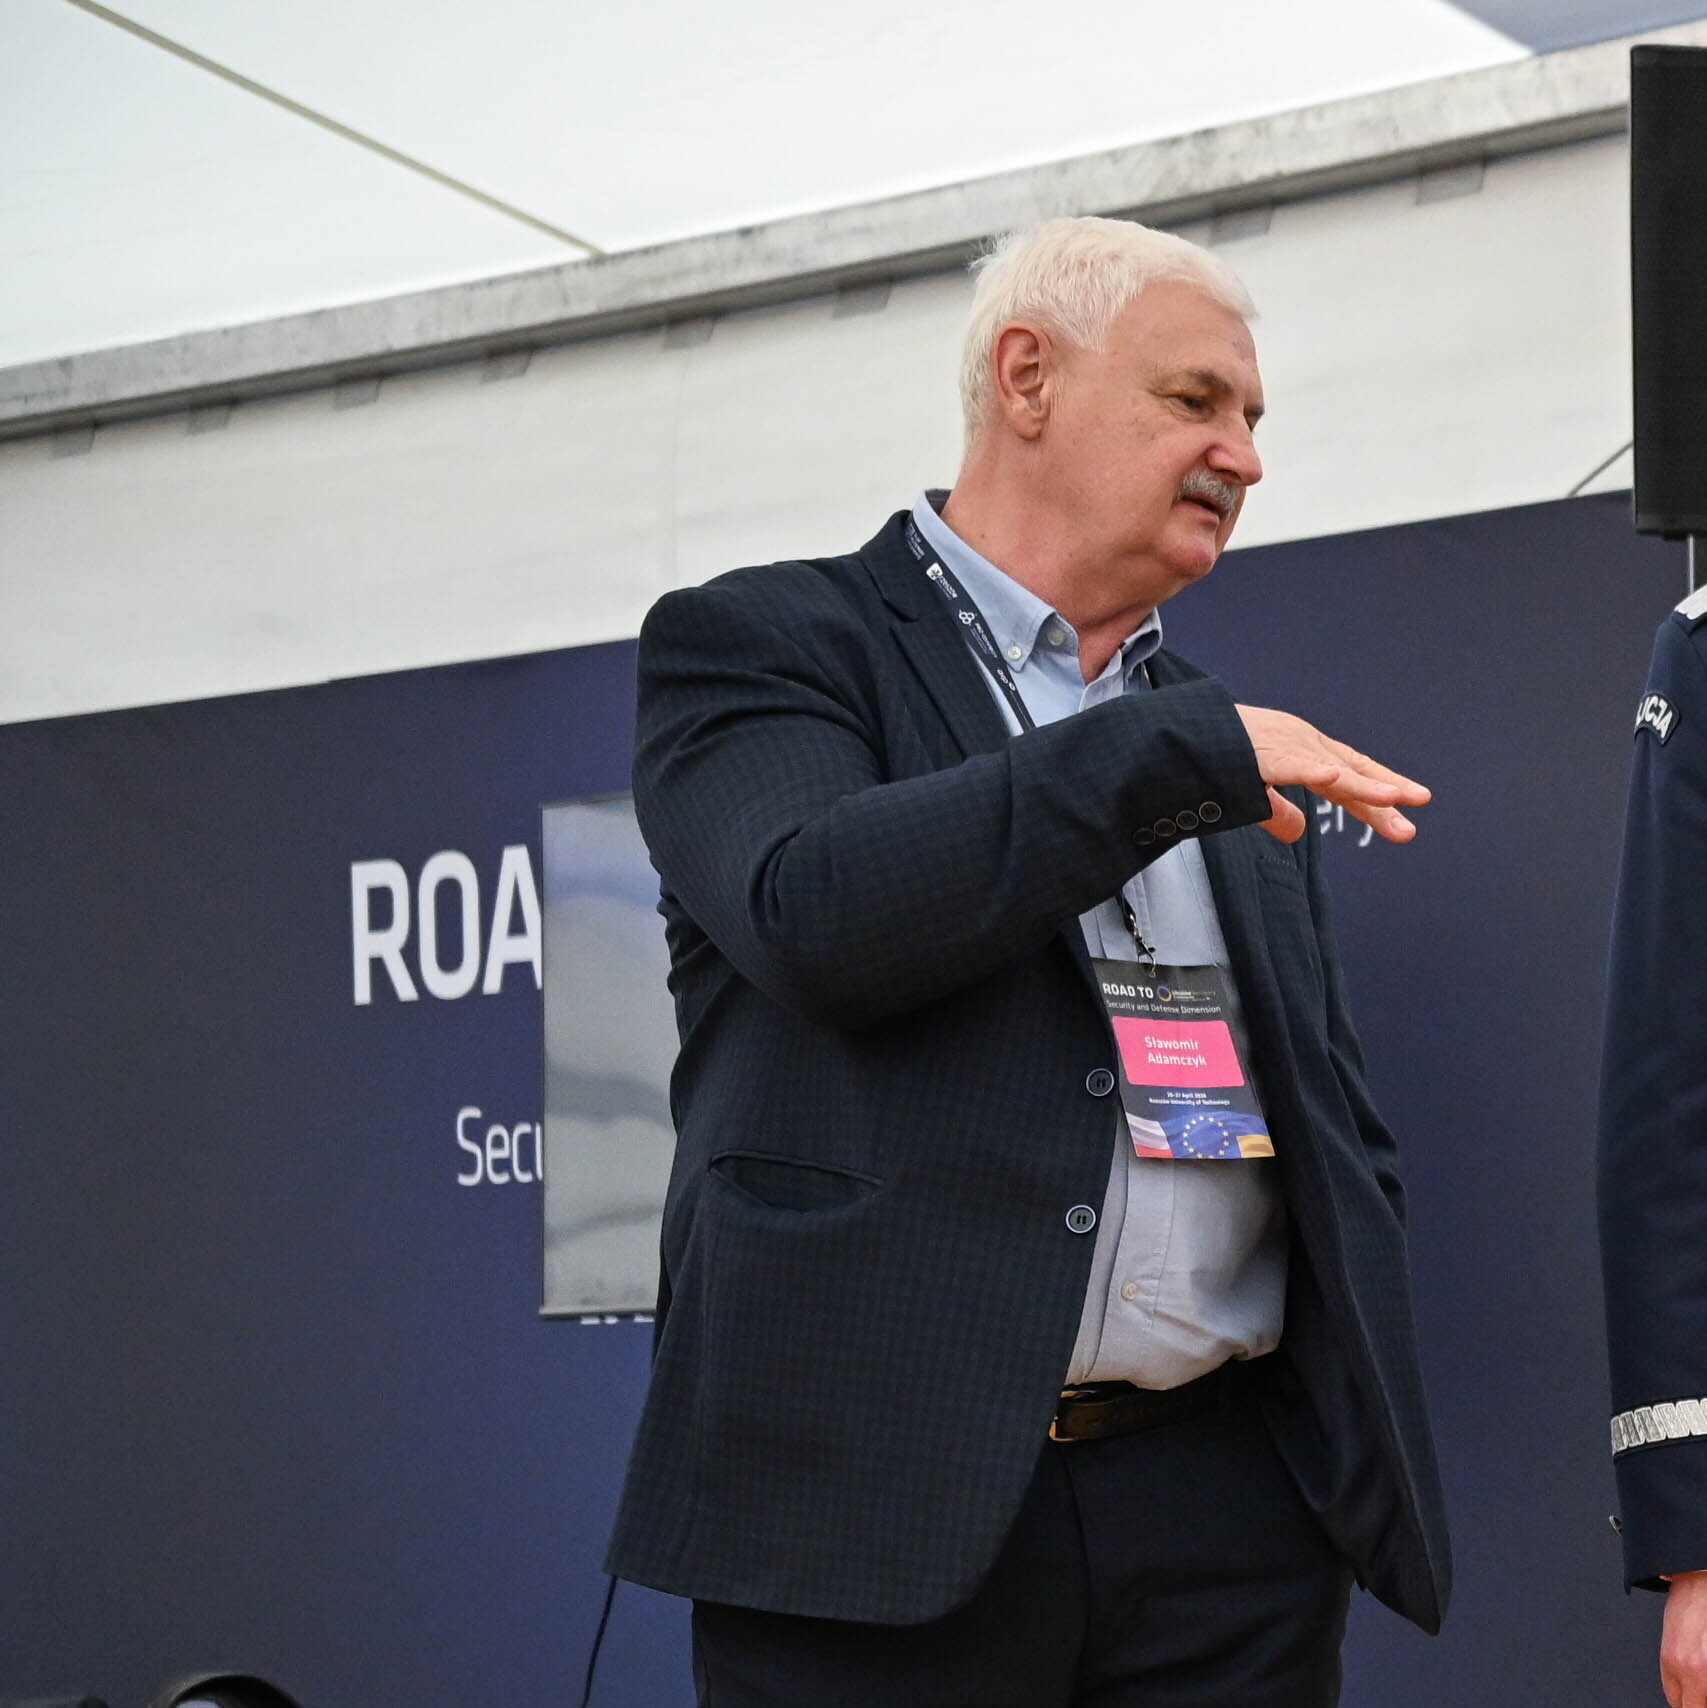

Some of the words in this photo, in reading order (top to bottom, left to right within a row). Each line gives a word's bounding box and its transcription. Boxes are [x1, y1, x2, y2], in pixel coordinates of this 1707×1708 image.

[1102, 983, 1136, 997] ROAD
[1137, 986, 1154, 999] TO
[1105, 999, 1135, 1011] Security
[1137, 1003, 1149, 1011] and
[1181, 1005, 1221, 1014] Dimension
[1144, 1036, 1199, 1050] Sławomir
[1148, 1053, 1207, 1068] Adamczyk
